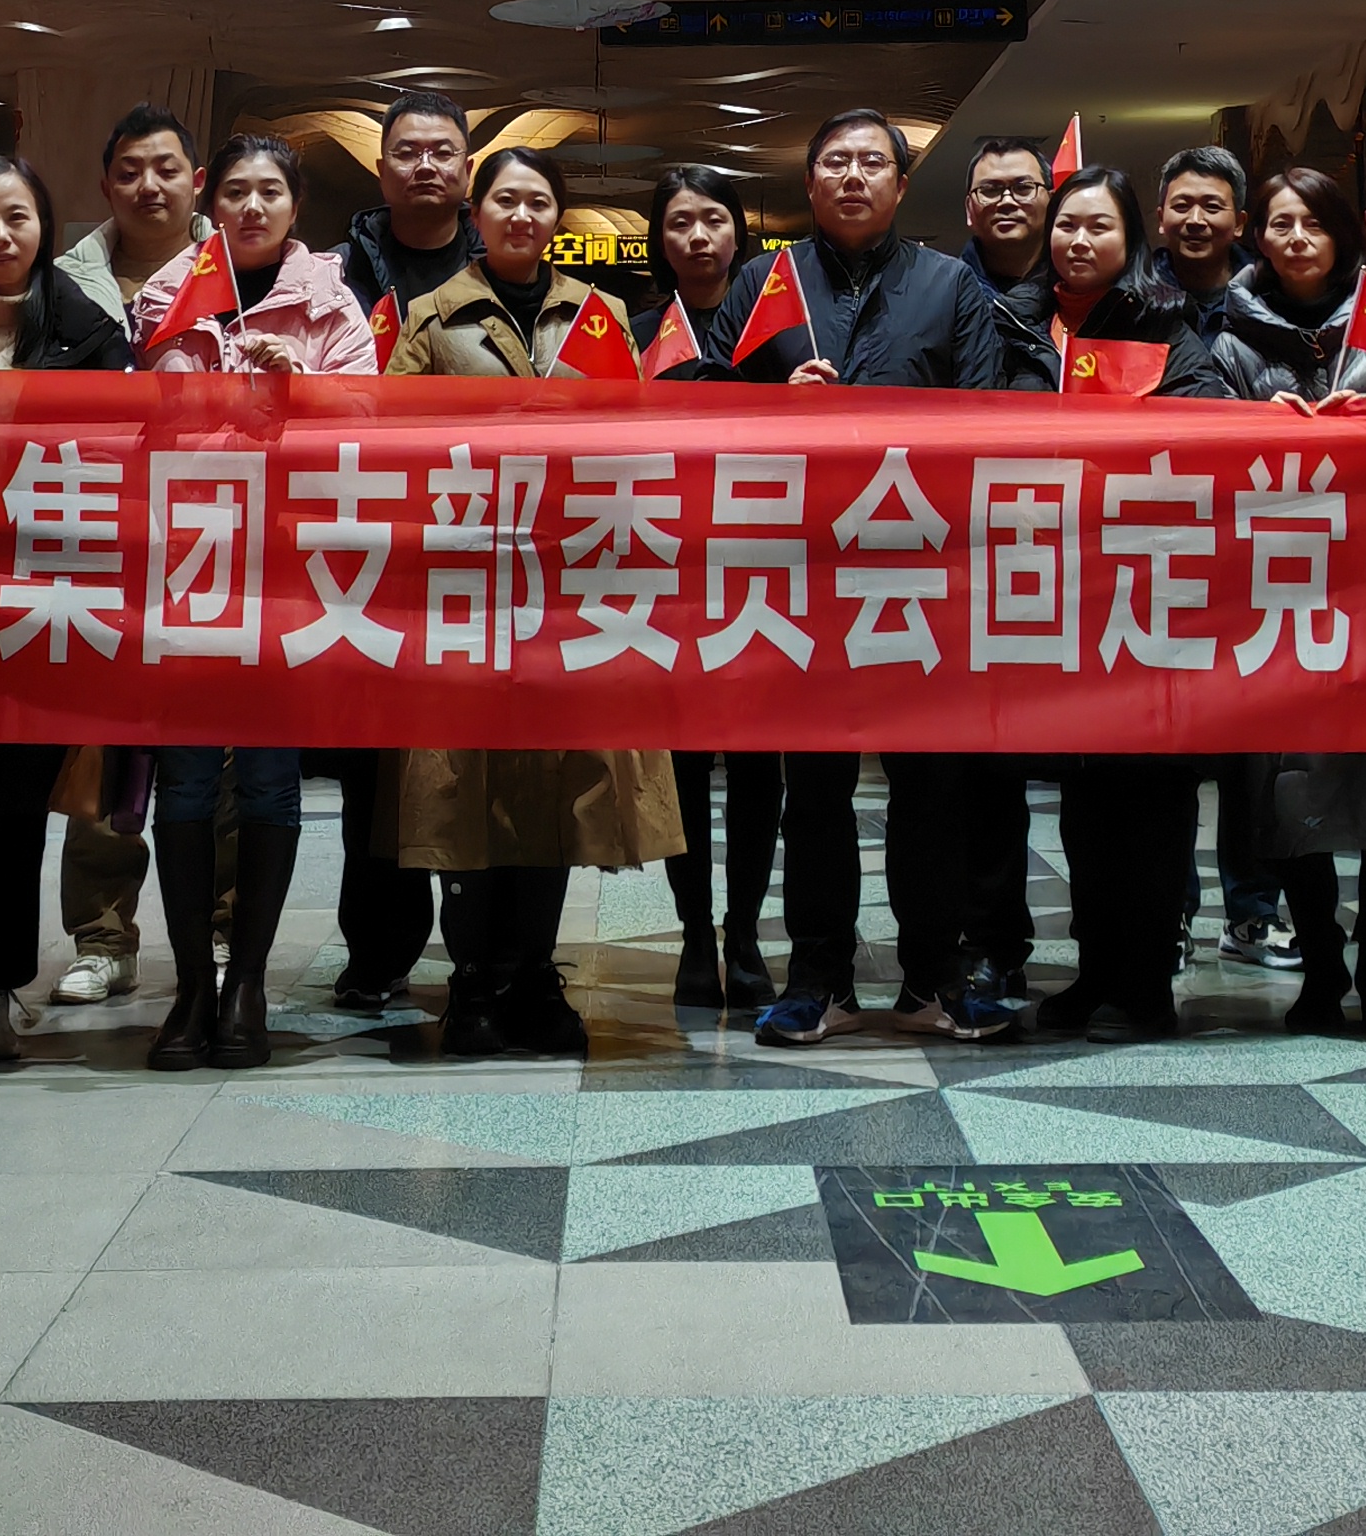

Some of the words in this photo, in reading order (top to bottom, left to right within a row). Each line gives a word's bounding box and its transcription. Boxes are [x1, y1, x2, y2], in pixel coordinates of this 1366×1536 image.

[542, 233, 617, 264] 空间
[914, 1179, 1072, 1192] EXIT
[873, 1191, 1123, 1208] 安全出口
